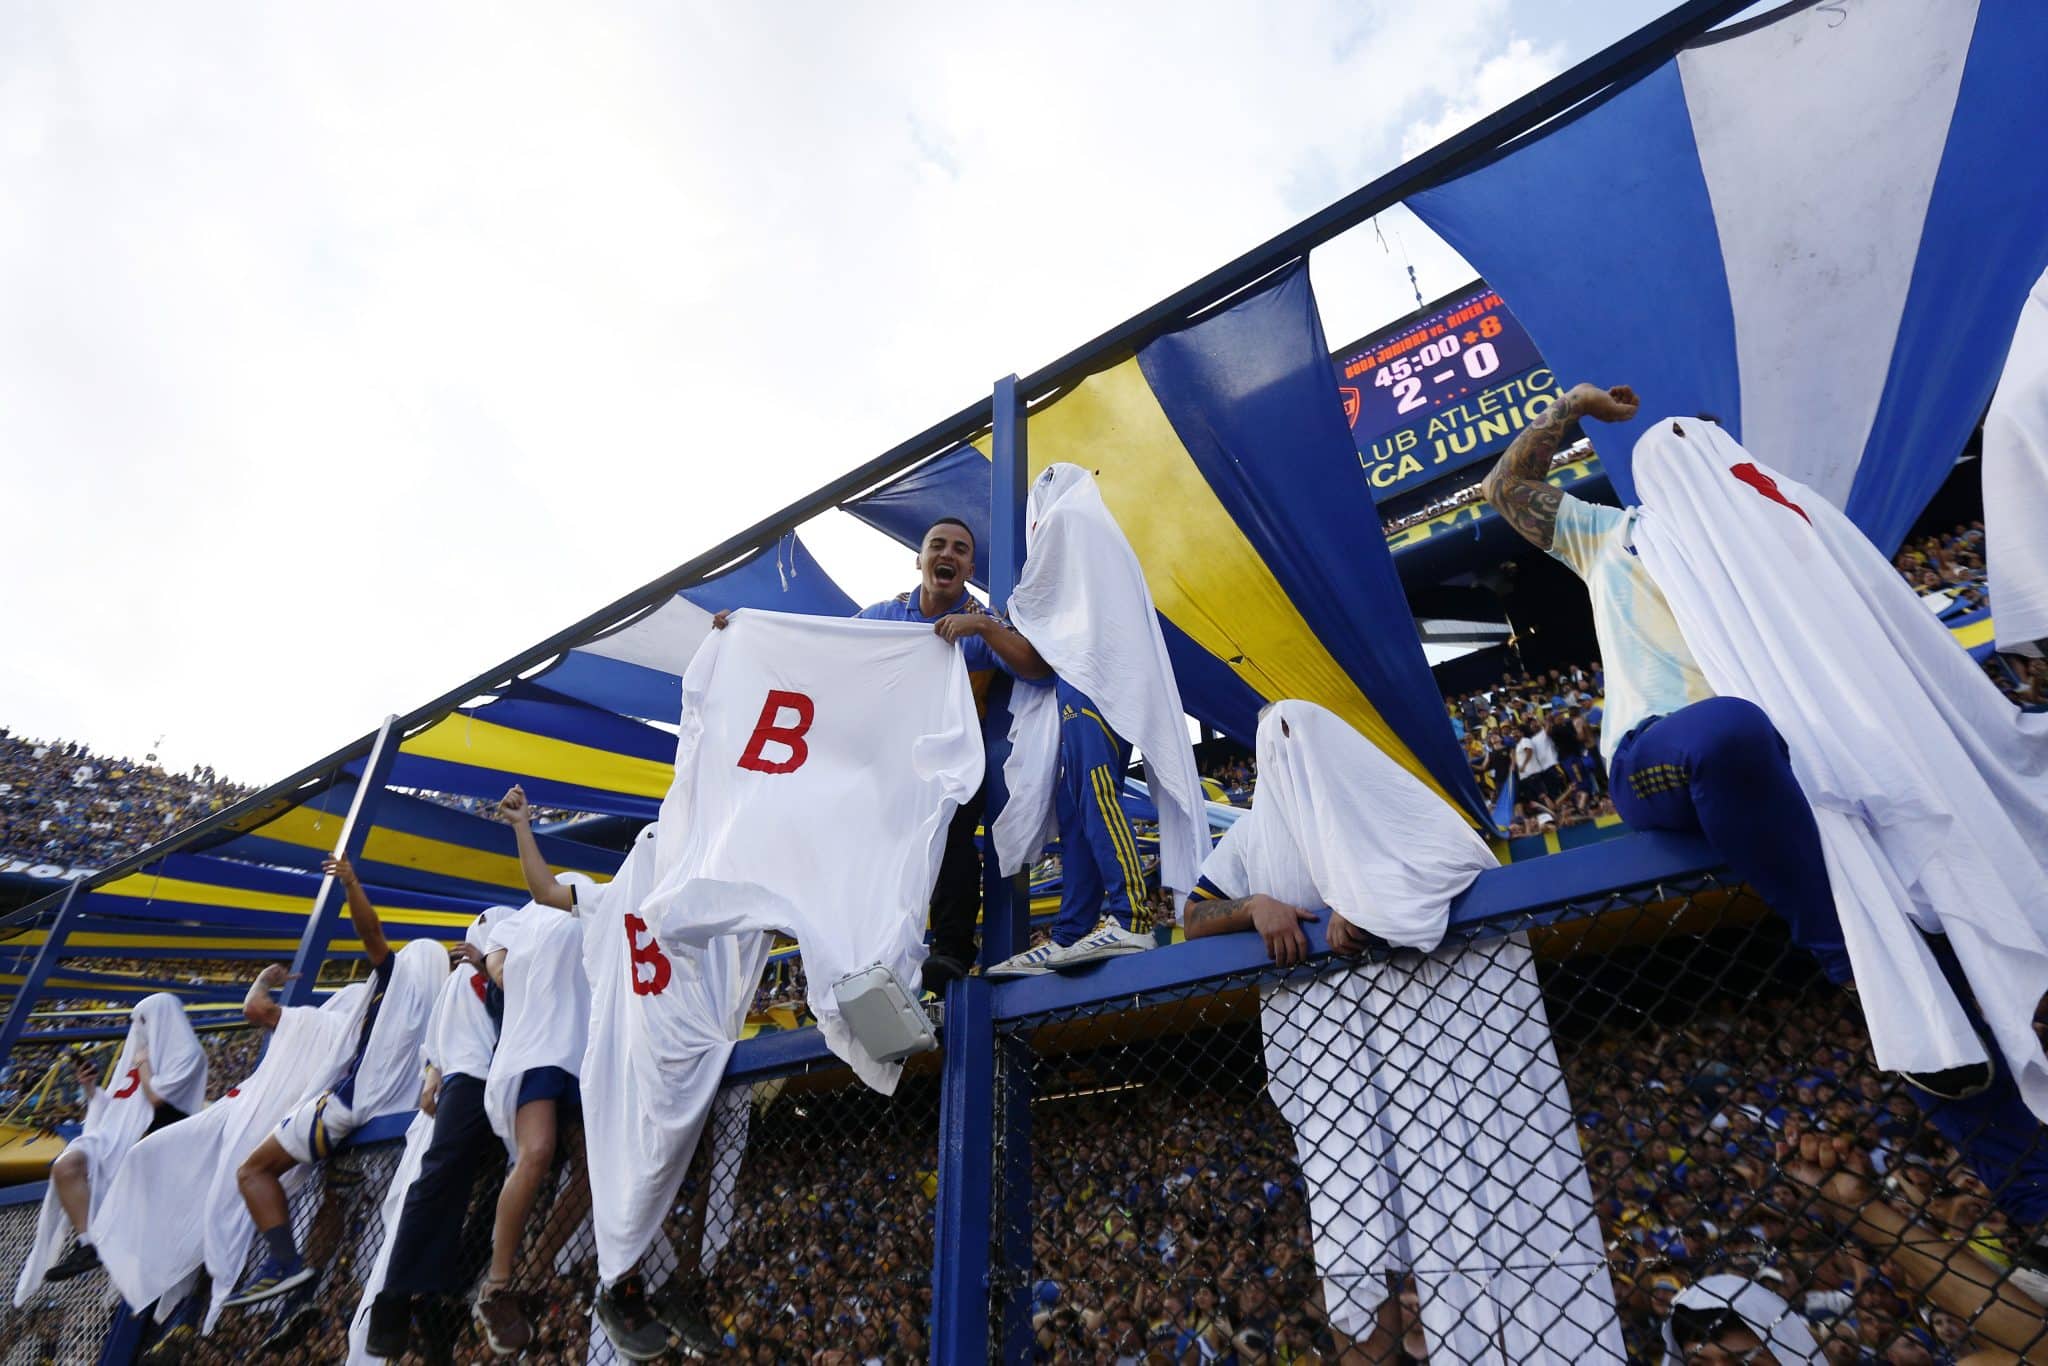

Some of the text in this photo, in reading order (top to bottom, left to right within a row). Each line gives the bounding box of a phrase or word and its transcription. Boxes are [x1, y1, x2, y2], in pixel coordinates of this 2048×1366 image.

[1375, 334, 1460, 387] 45:00
[1462, 315, 1503, 345] +8
[1392, 376, 1427, 415] 2
[1462, 342, 1500, 379] 0
[1367, 387, 1565, 488] CA JUNIO
[737, 689, 815, 775] B
[624, 912, 671, 996] B
